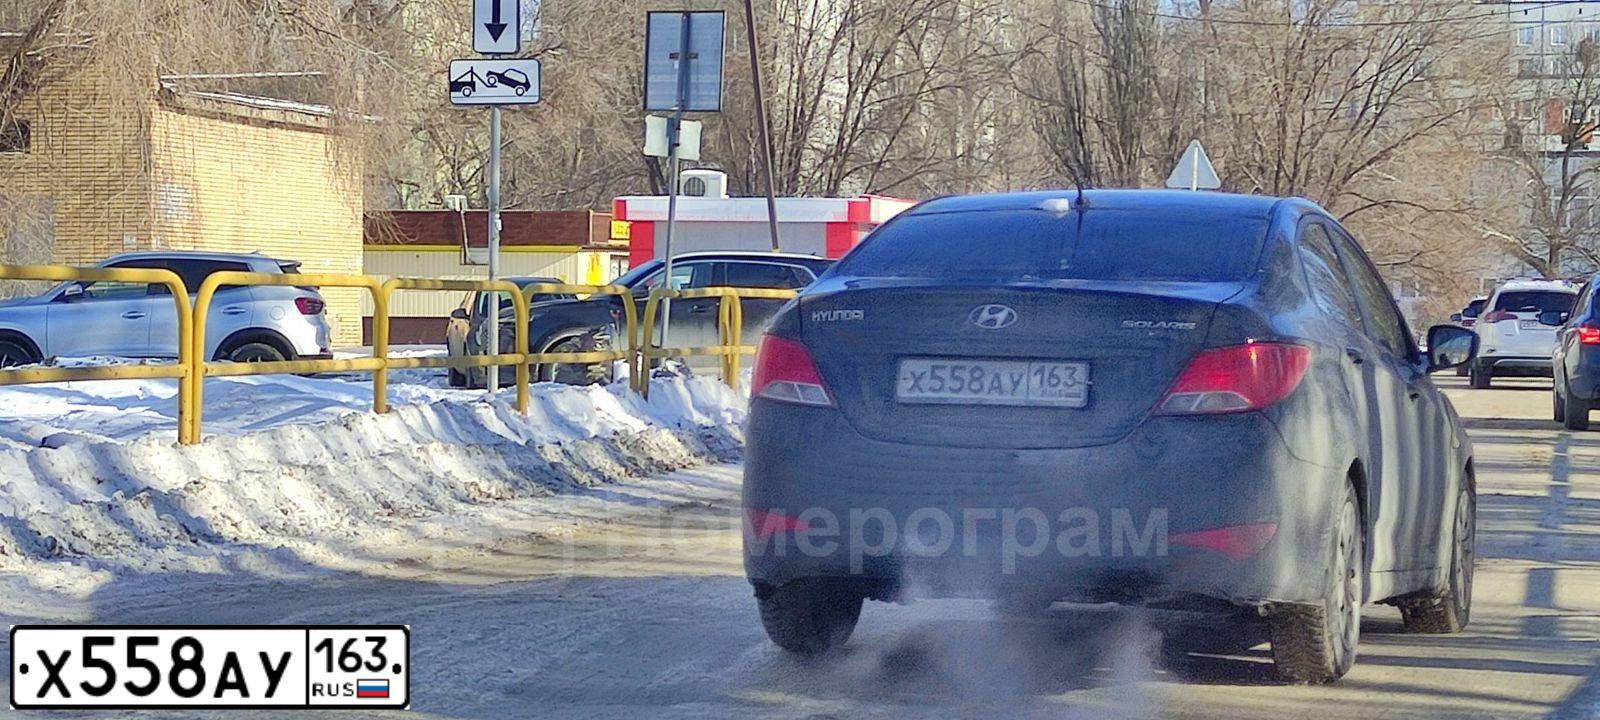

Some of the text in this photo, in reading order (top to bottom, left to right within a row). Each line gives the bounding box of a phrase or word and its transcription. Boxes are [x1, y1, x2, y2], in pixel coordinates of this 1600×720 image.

[811, 309, 864, 321] HYUNDAI
[1121, 320, 1197, 330] SOLARIS
[907, 364, 1077, 395] Х558АУ 163
